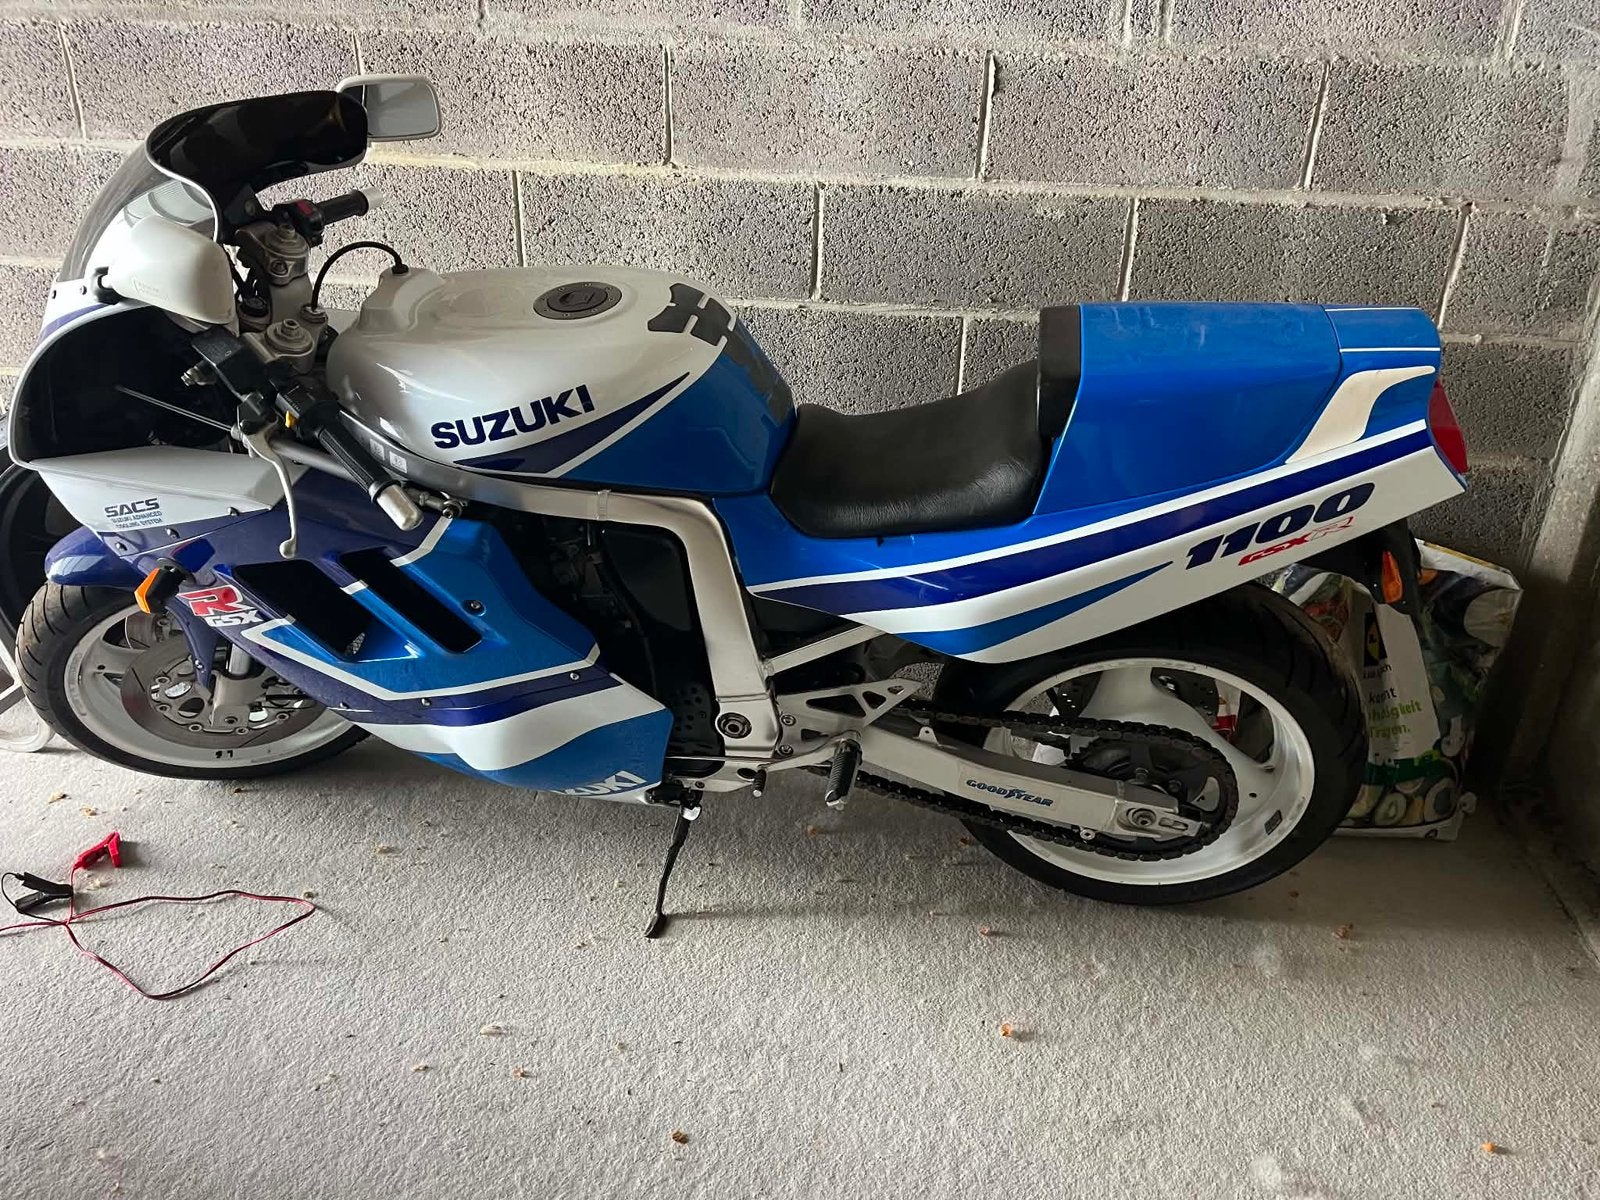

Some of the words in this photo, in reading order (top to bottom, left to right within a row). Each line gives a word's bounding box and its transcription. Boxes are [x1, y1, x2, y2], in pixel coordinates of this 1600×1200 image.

[430, 384, 595, 449] SUZUKI
[104, 497, 160, 518] SACS
[1185, 482, 1376, 570] 1100
[203, 609, 264, 627] GSX
[965, 778, 1055, 807] GOODYEAR
